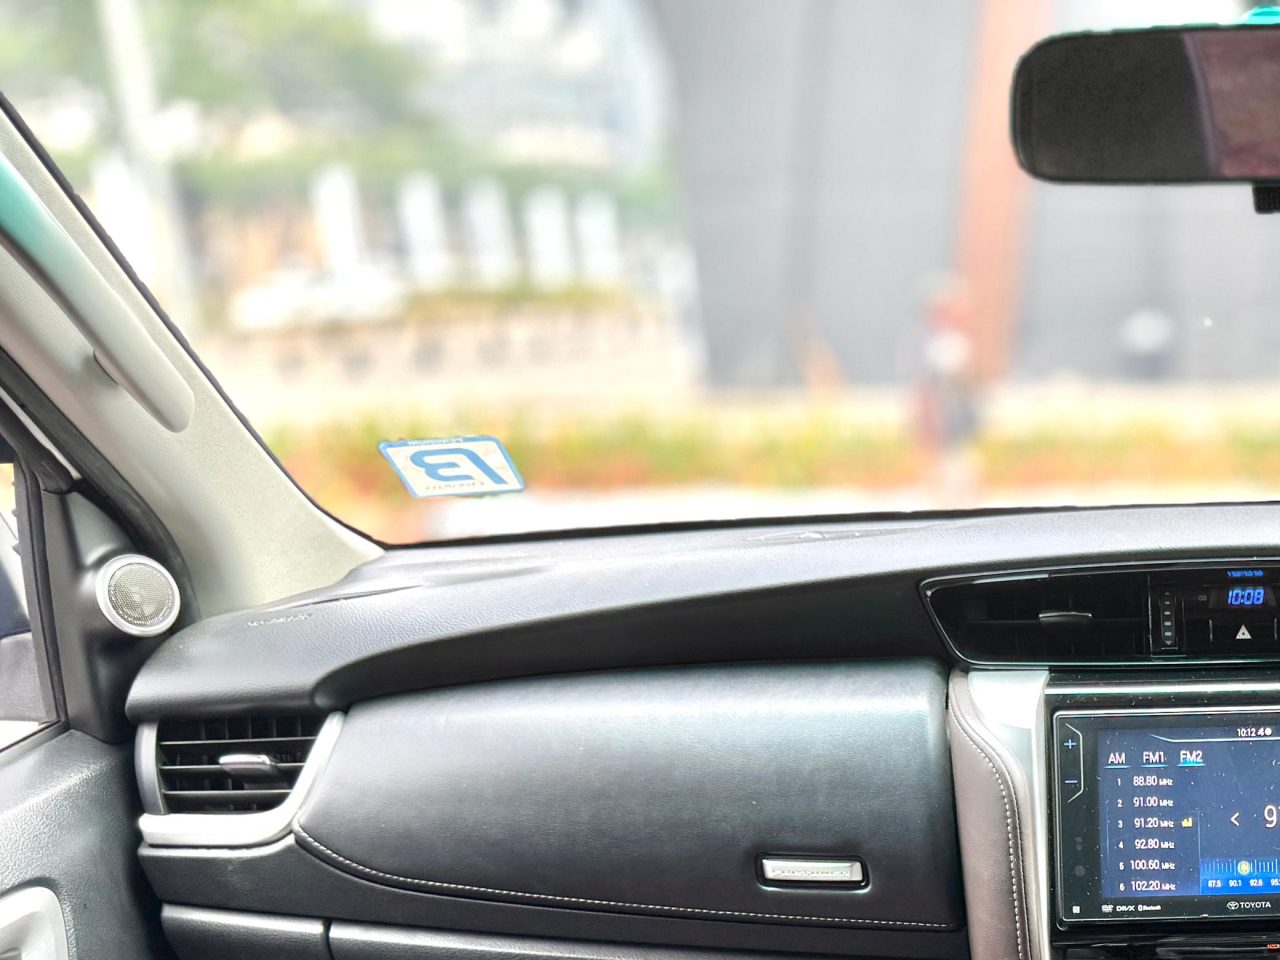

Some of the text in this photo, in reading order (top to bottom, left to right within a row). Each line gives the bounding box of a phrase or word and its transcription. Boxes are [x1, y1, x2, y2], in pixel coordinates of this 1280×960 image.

[1228, 587, 1264, 605] 10:08
[1237, 728, 1256, 737] 10:12
[1108, 752, 1125, 764] AM
[1143, 752, 1164, 763] FM1
[1180, 751, 1203, 763] FM2
[1117, 778, 1121, 786] 1
[1133, 776, 1158, 786] 88.80
[1117, 799, 1123, 807] 2
[1133, 797, 1158, 807] 91.00
[1118, 820, 1123, 828] 3
[1134, 817, 1159, 828] 91.20
[1119, 841, 1123, 849] 4
[1135, 839, 1159, 849] 92.80
[1130, 860, 1160, 870] 100.60
[1120, 883, 1125, 891] 6
[1131, 881, 1160, 891] 102.20
[1240, 901, 1272, 909] TOYOTA
